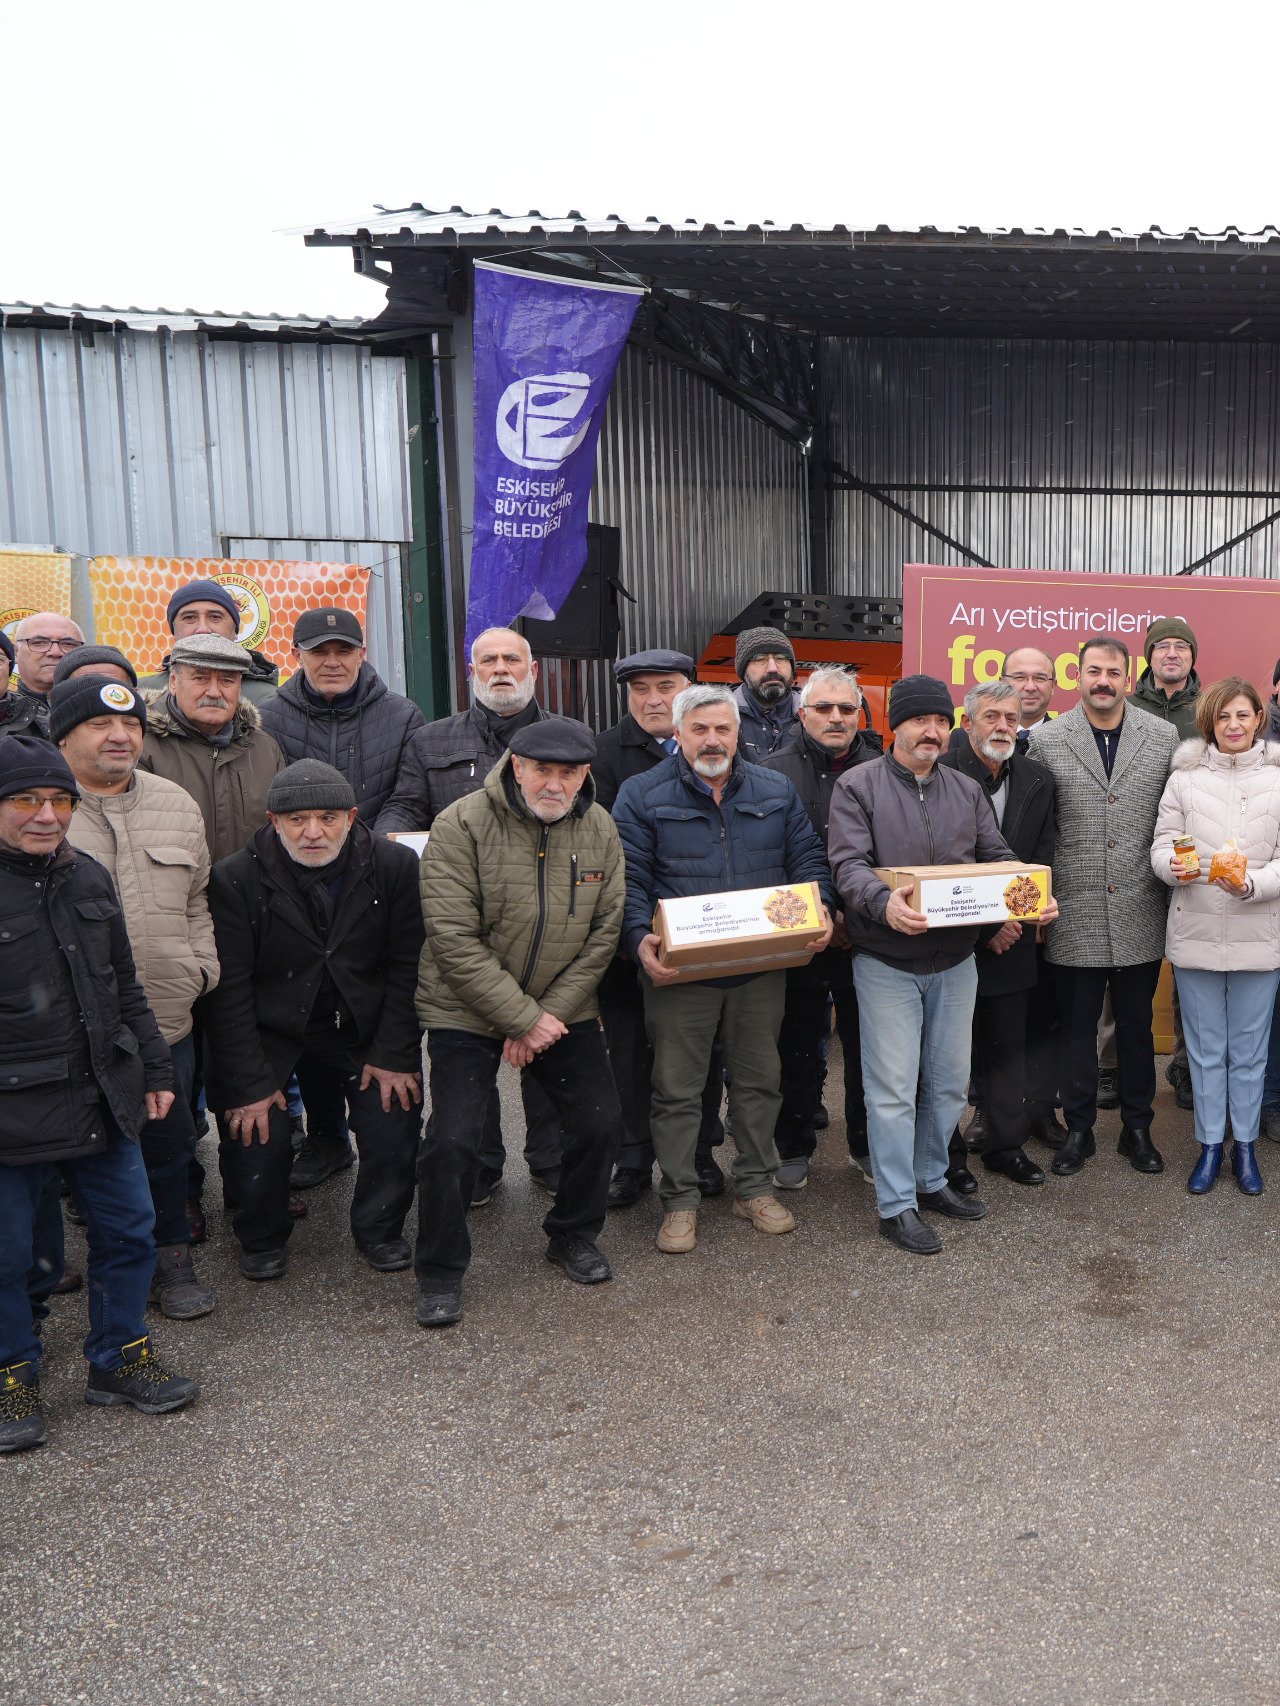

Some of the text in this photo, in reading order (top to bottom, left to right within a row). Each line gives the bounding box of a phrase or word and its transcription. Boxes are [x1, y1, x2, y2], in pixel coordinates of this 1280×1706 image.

[497, 477, 565, 497] ESKİŞEHİR
[494, 512, 562, 539] BELEDİESİ
[216, 576, 249, 588] İŞEHİR
[949, 602, 1188, 633] Arı yetiştiricileri
